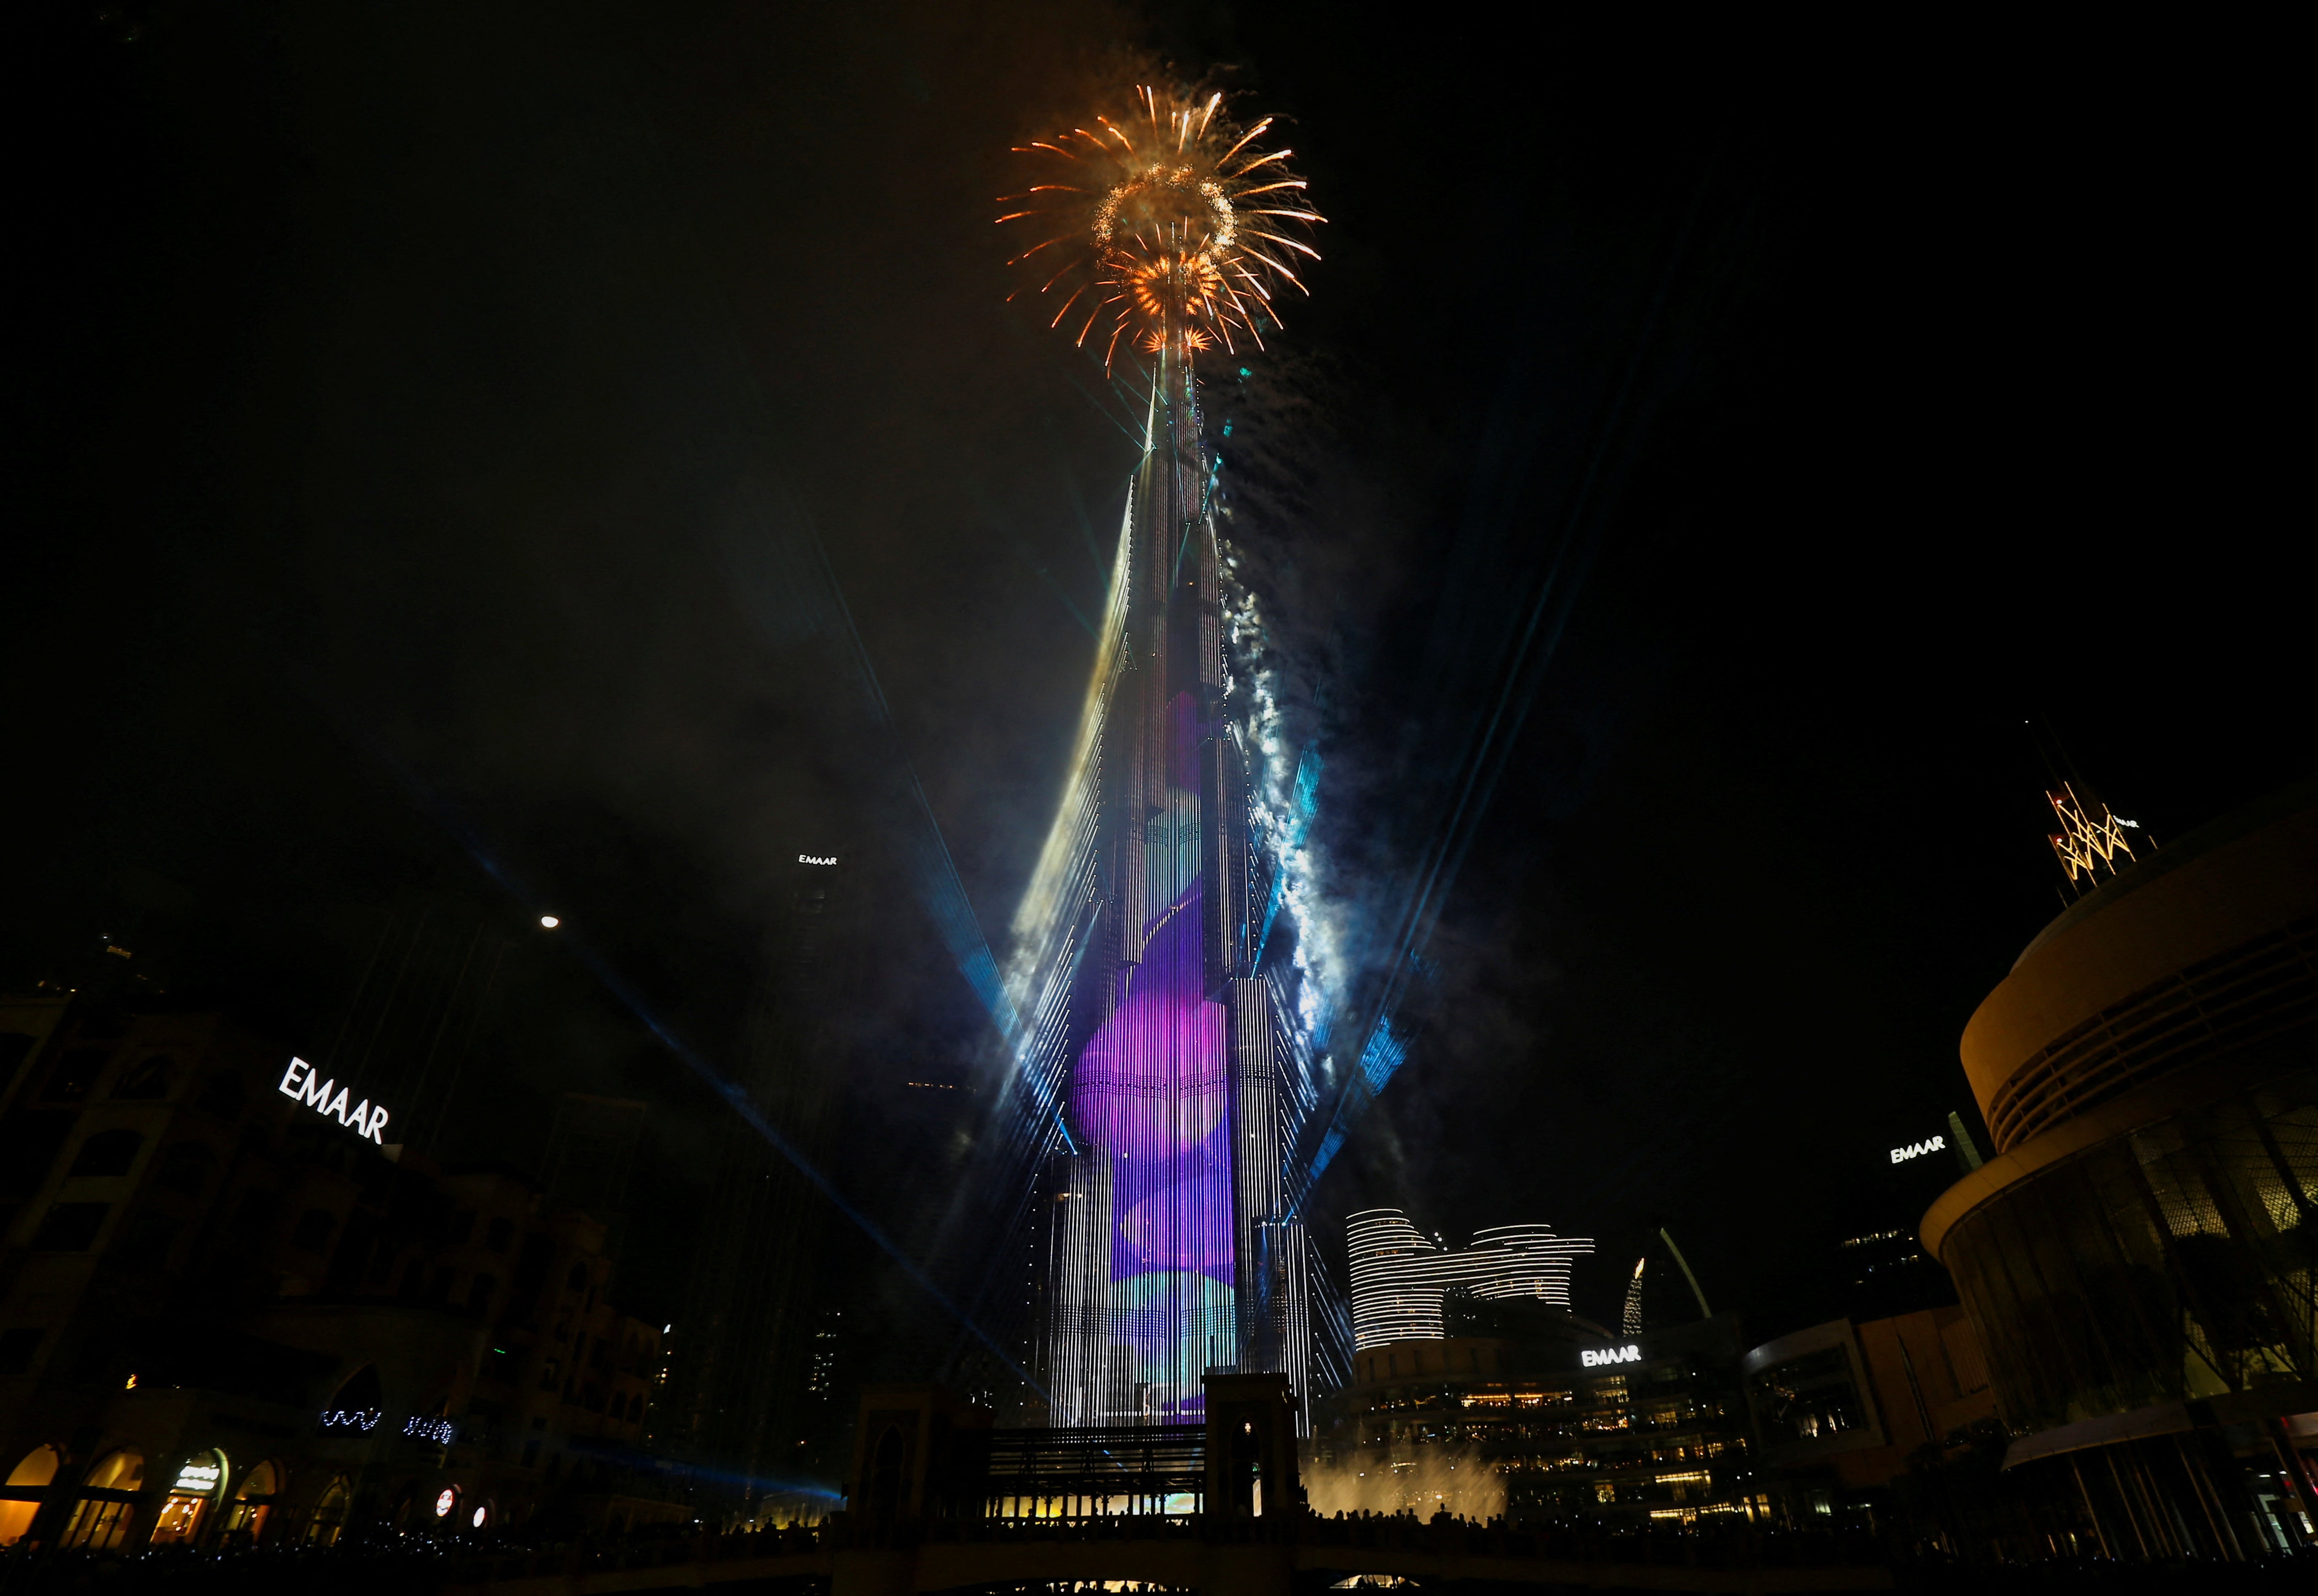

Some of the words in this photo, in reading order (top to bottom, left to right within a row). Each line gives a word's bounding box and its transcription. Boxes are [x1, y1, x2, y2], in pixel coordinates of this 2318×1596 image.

[798, 854, 837, 865] EMAAR
[279, 1056, 389, 1145] EMAAR
[1890, 1135, 1946, 1164] EMAAR
[1580, 1344, 1642, 1367] EMAAR
